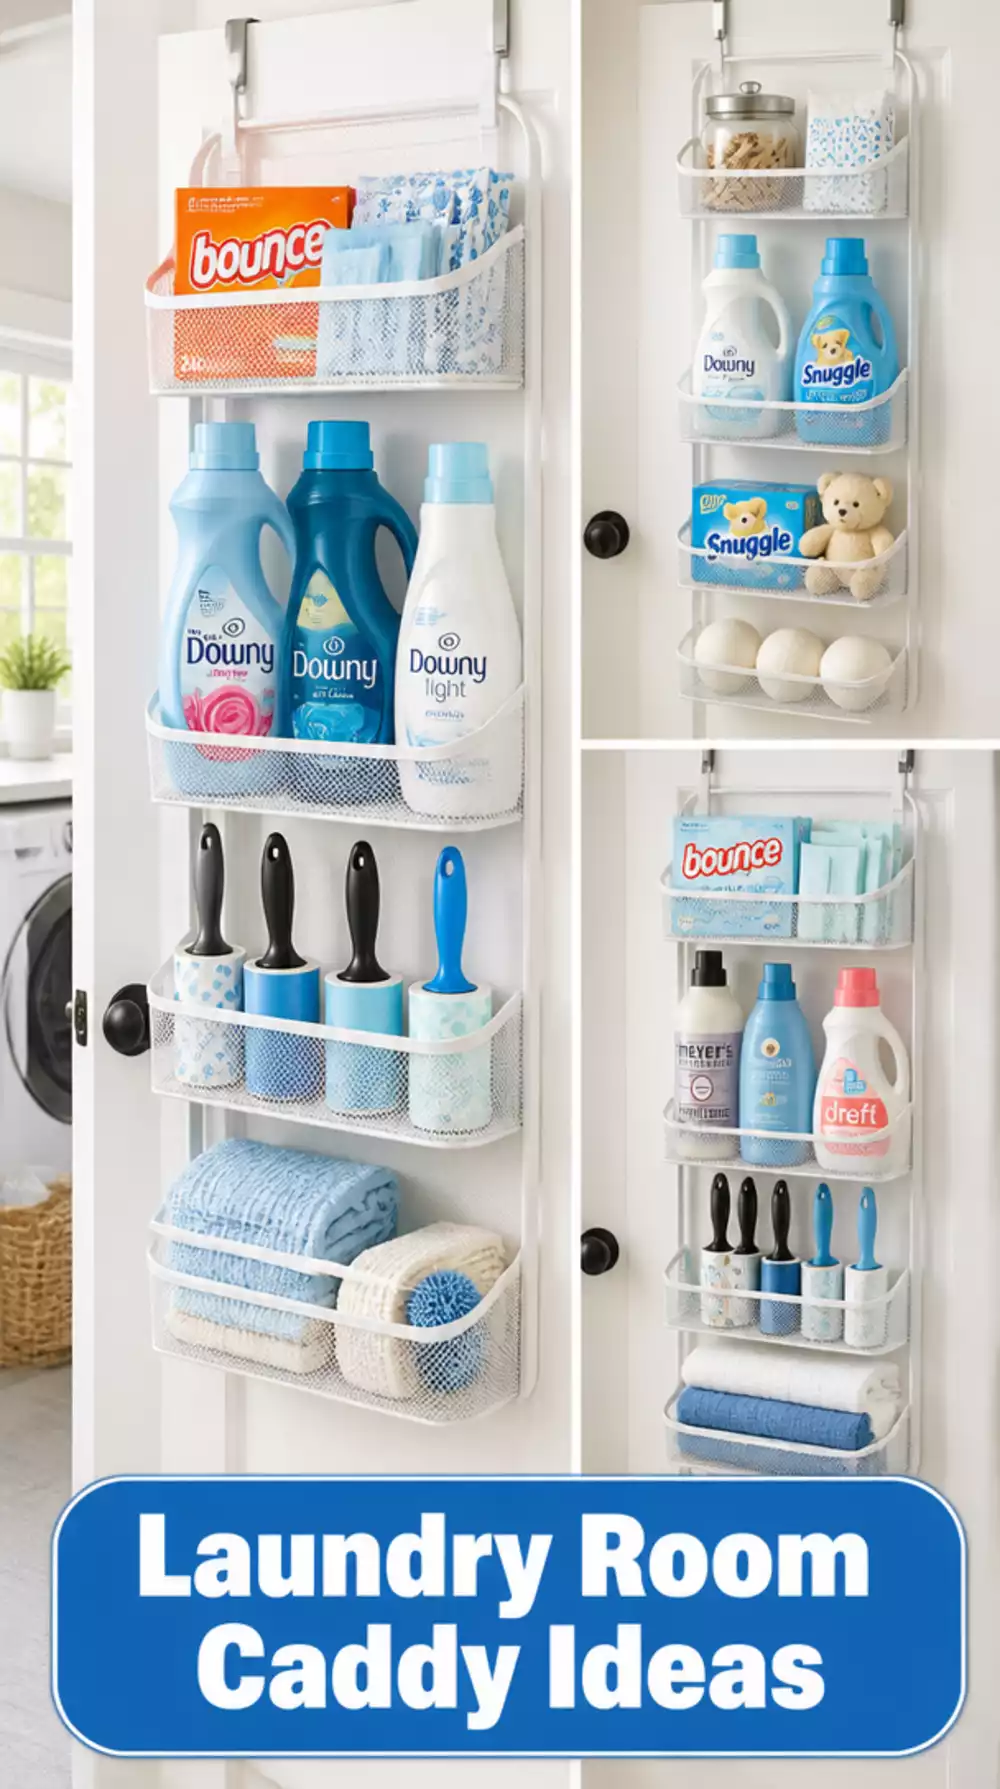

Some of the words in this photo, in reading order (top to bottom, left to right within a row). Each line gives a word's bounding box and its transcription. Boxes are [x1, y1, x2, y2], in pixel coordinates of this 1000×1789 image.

[191, 221, 327, 288] bounce
[703, 354, 756, 378] Downy
[803, 358, 871, 386] Snuggle
[707, 527, 791, 560] Snuggle
[187, 636, 274, 674] Downy
[293, 650, 377, 689] Downy
[410, 648, 487, 684] Downy
[425, 679, 467, 703] light
[684, 838, 783, 878] bounce
[825, 1100, 877, 1125] dreft
